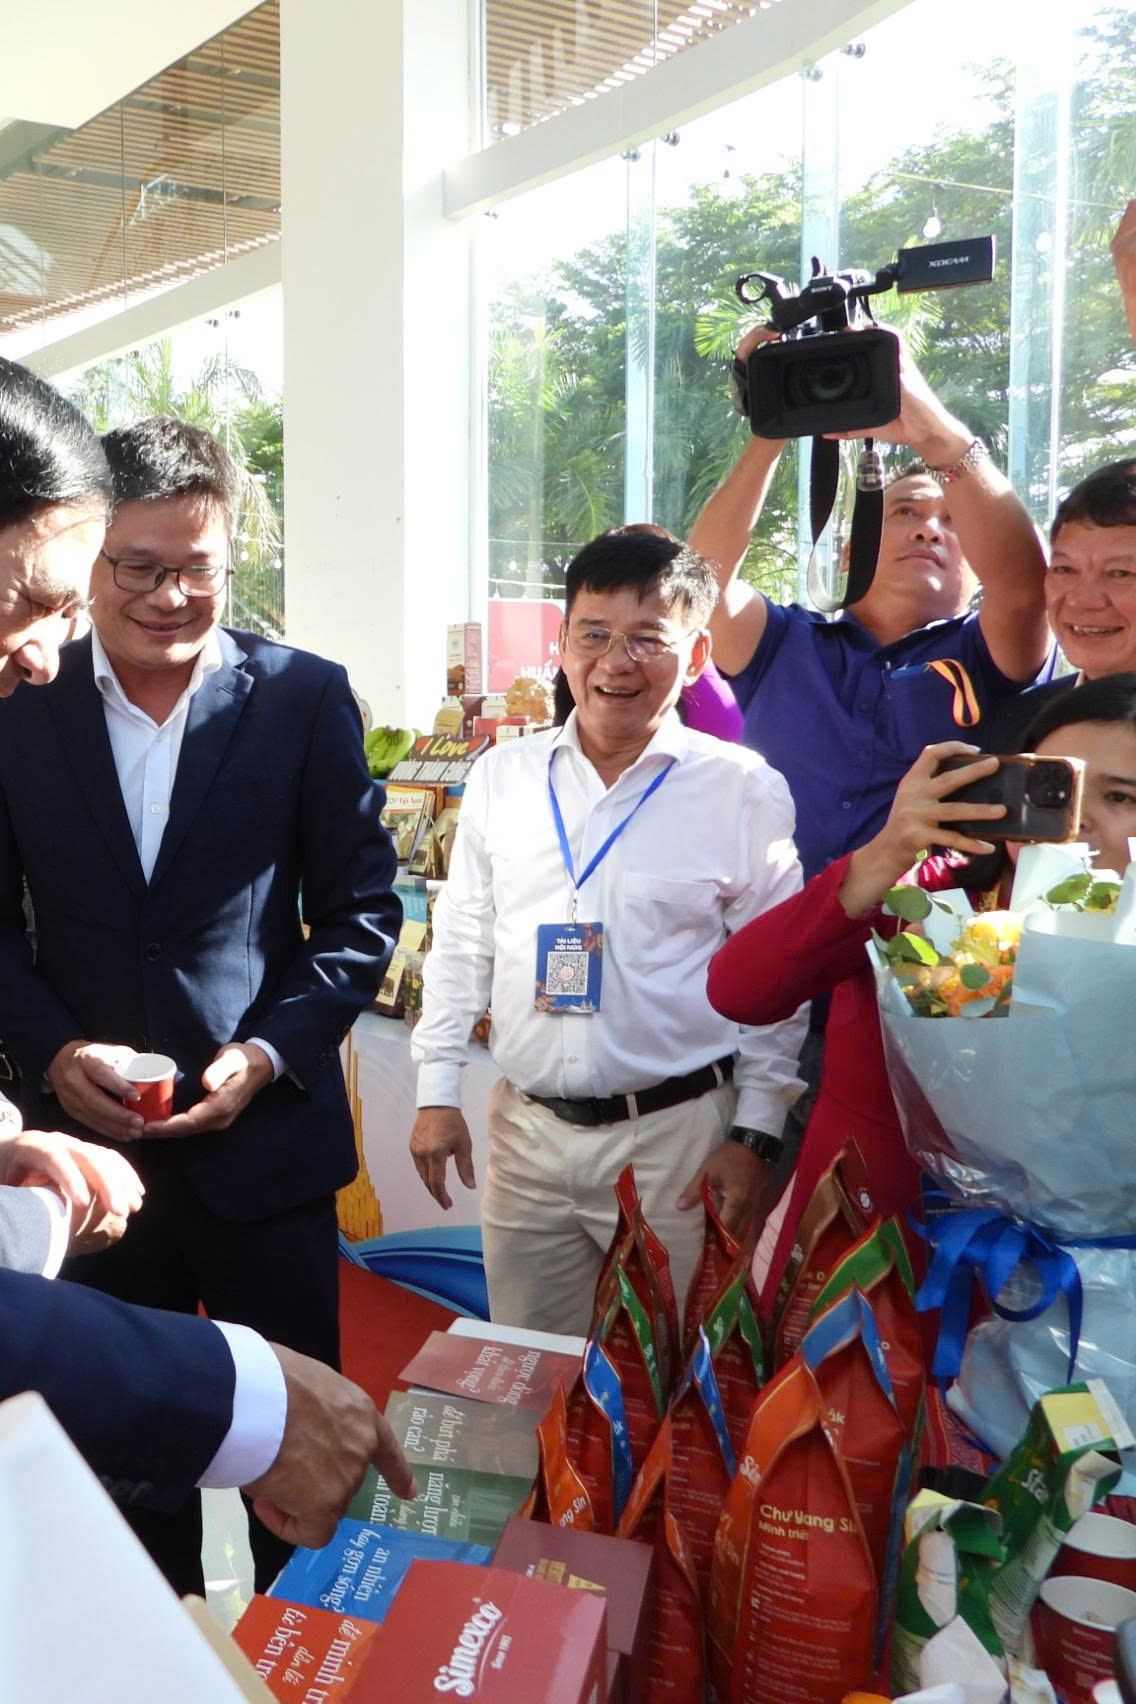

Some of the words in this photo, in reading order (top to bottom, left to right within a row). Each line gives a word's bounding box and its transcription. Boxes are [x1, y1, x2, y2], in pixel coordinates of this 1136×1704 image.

[811, 285, 833, 293] SONY
[520, 659, 561, 681] HUẤ
[430, 737, 469, 757] Love
[429, 1436, 457, 1463] phá
[417, 1472, 450, 1505] năng
[349, 1528, 382, 1549] hay
[371, 1547, 391, 1565] an
[353, 1565, 387, 1601] nhiên
[264, 1626, 302, 1656] bên
[434, 1601, 503, 1697] Simexco
[314, 1638, 353, 1684] minh
